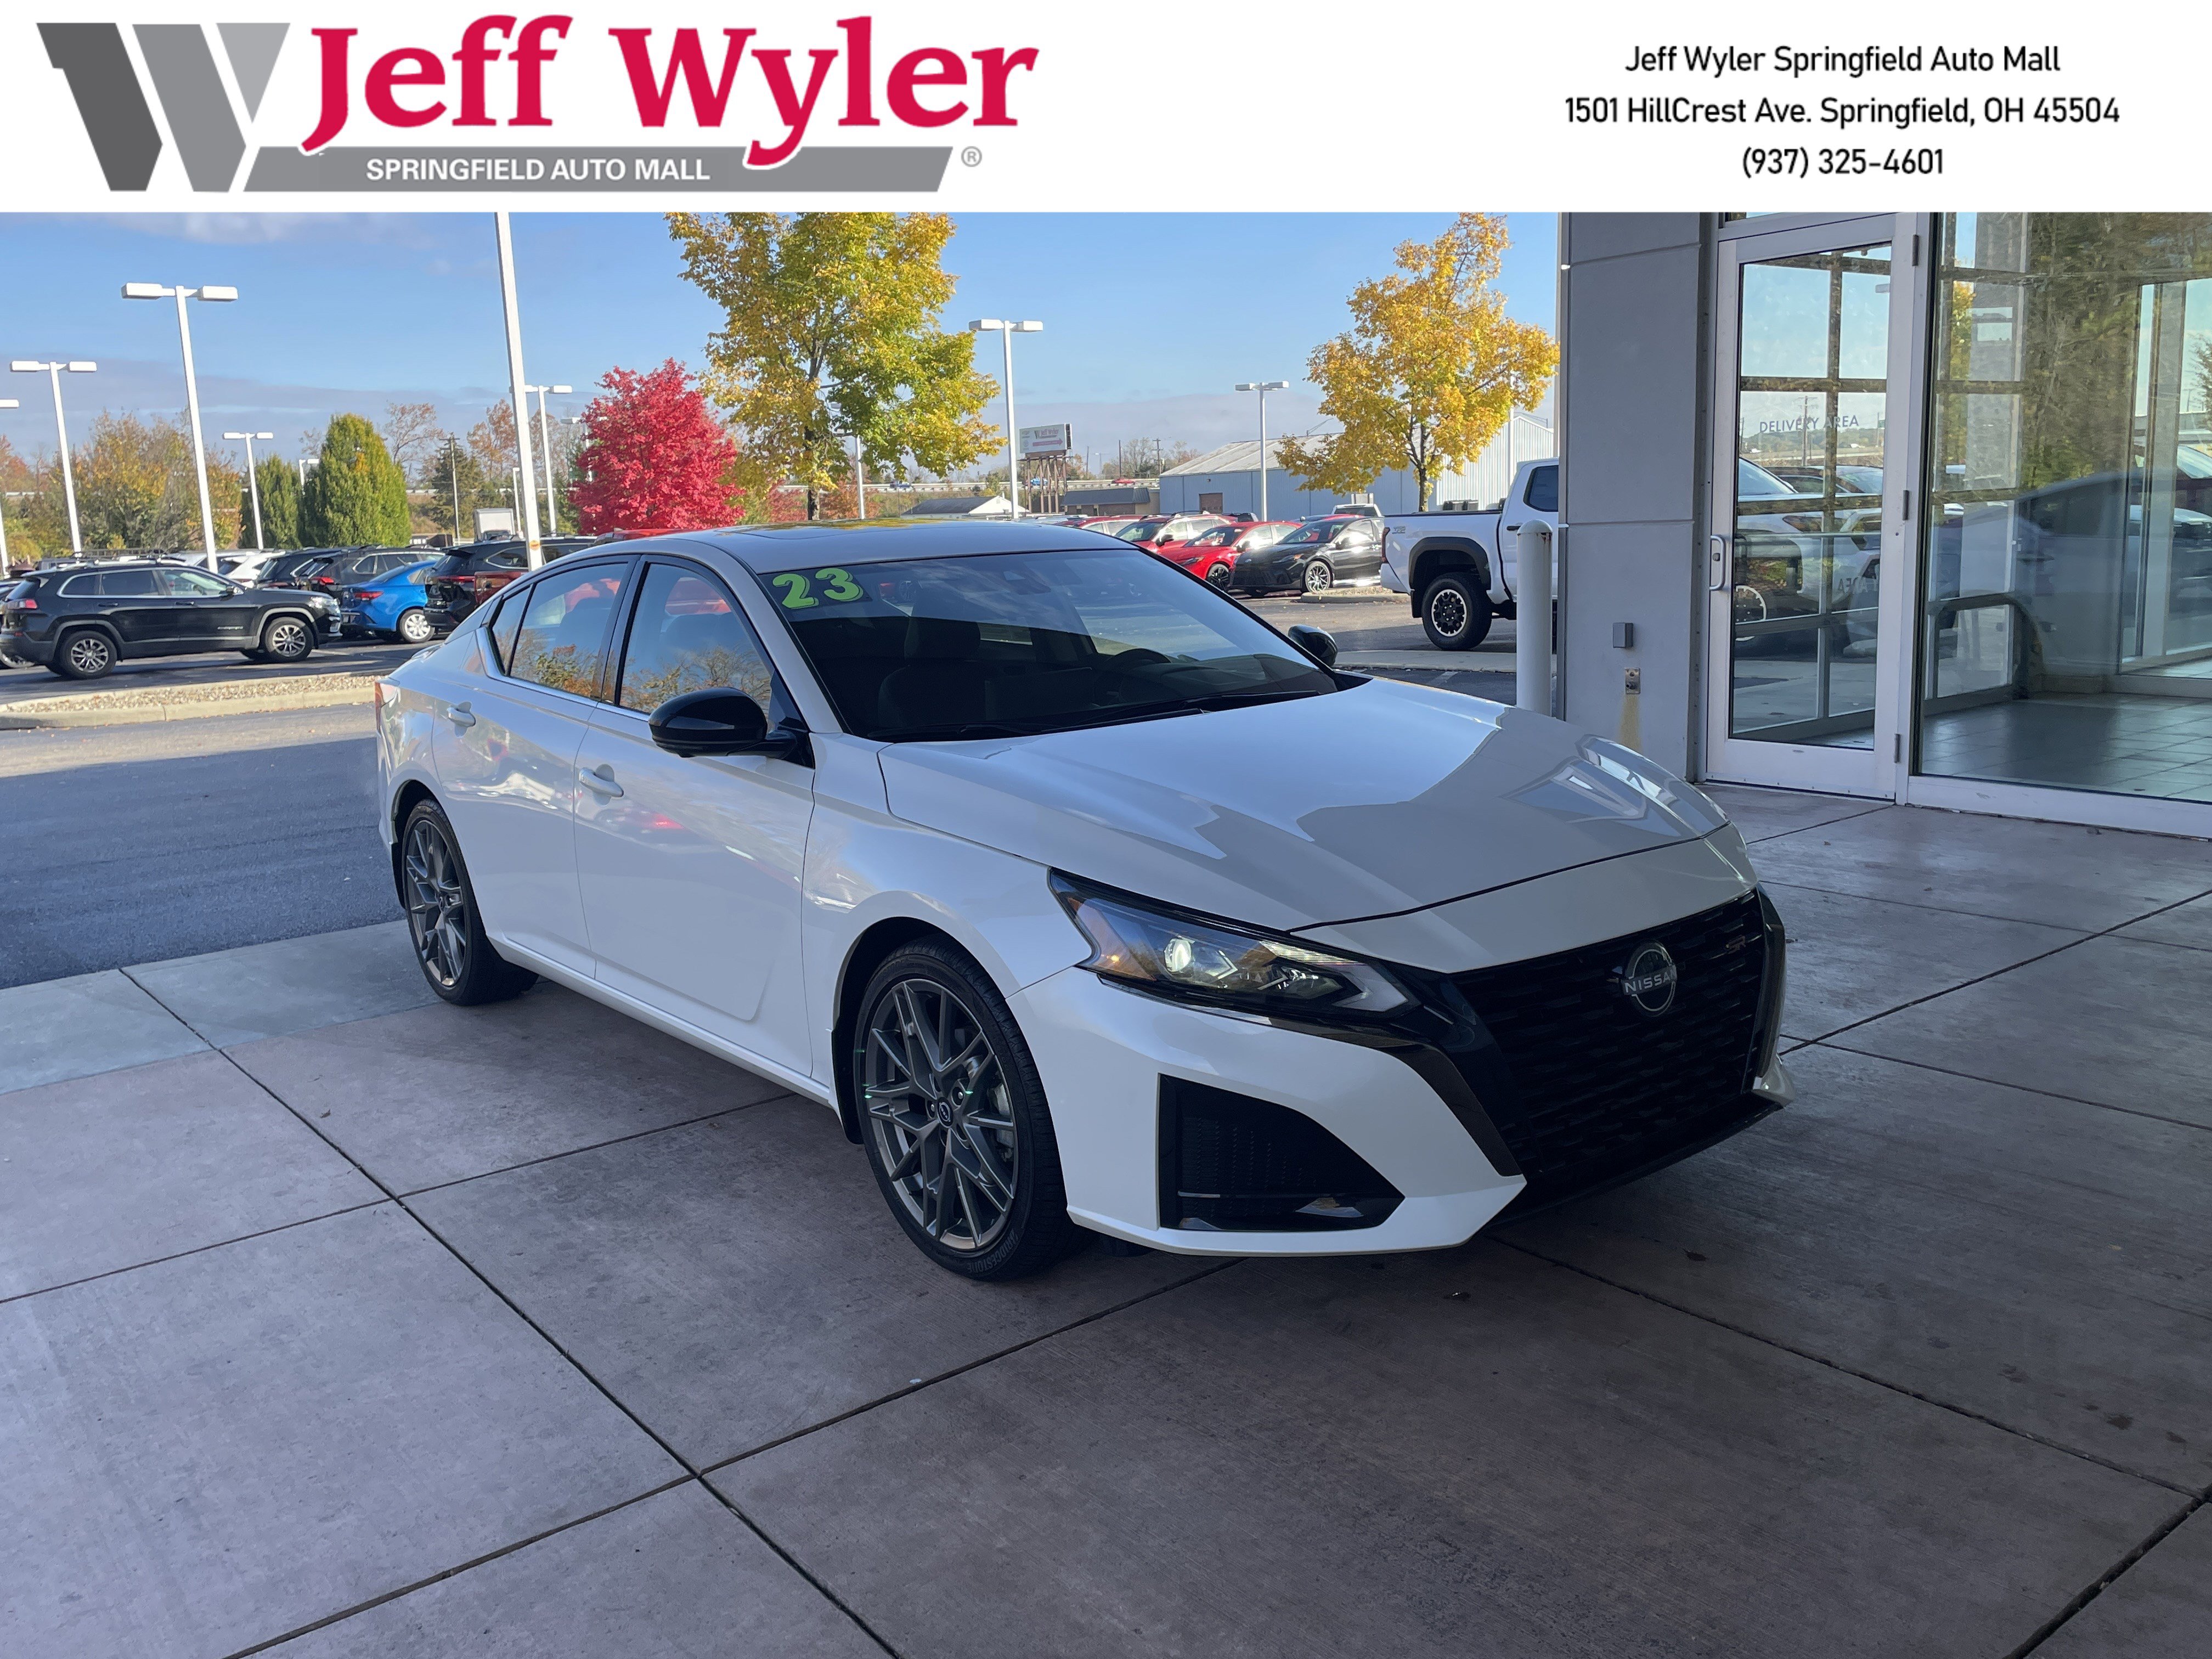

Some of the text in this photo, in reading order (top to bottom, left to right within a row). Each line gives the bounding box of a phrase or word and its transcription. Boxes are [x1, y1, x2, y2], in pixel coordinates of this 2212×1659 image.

[1759, 414, 1859, 433] DELIVERY AREA
[772, 567, 864, 610] 23
[1624, 968, 1677, 994] NISSAN
